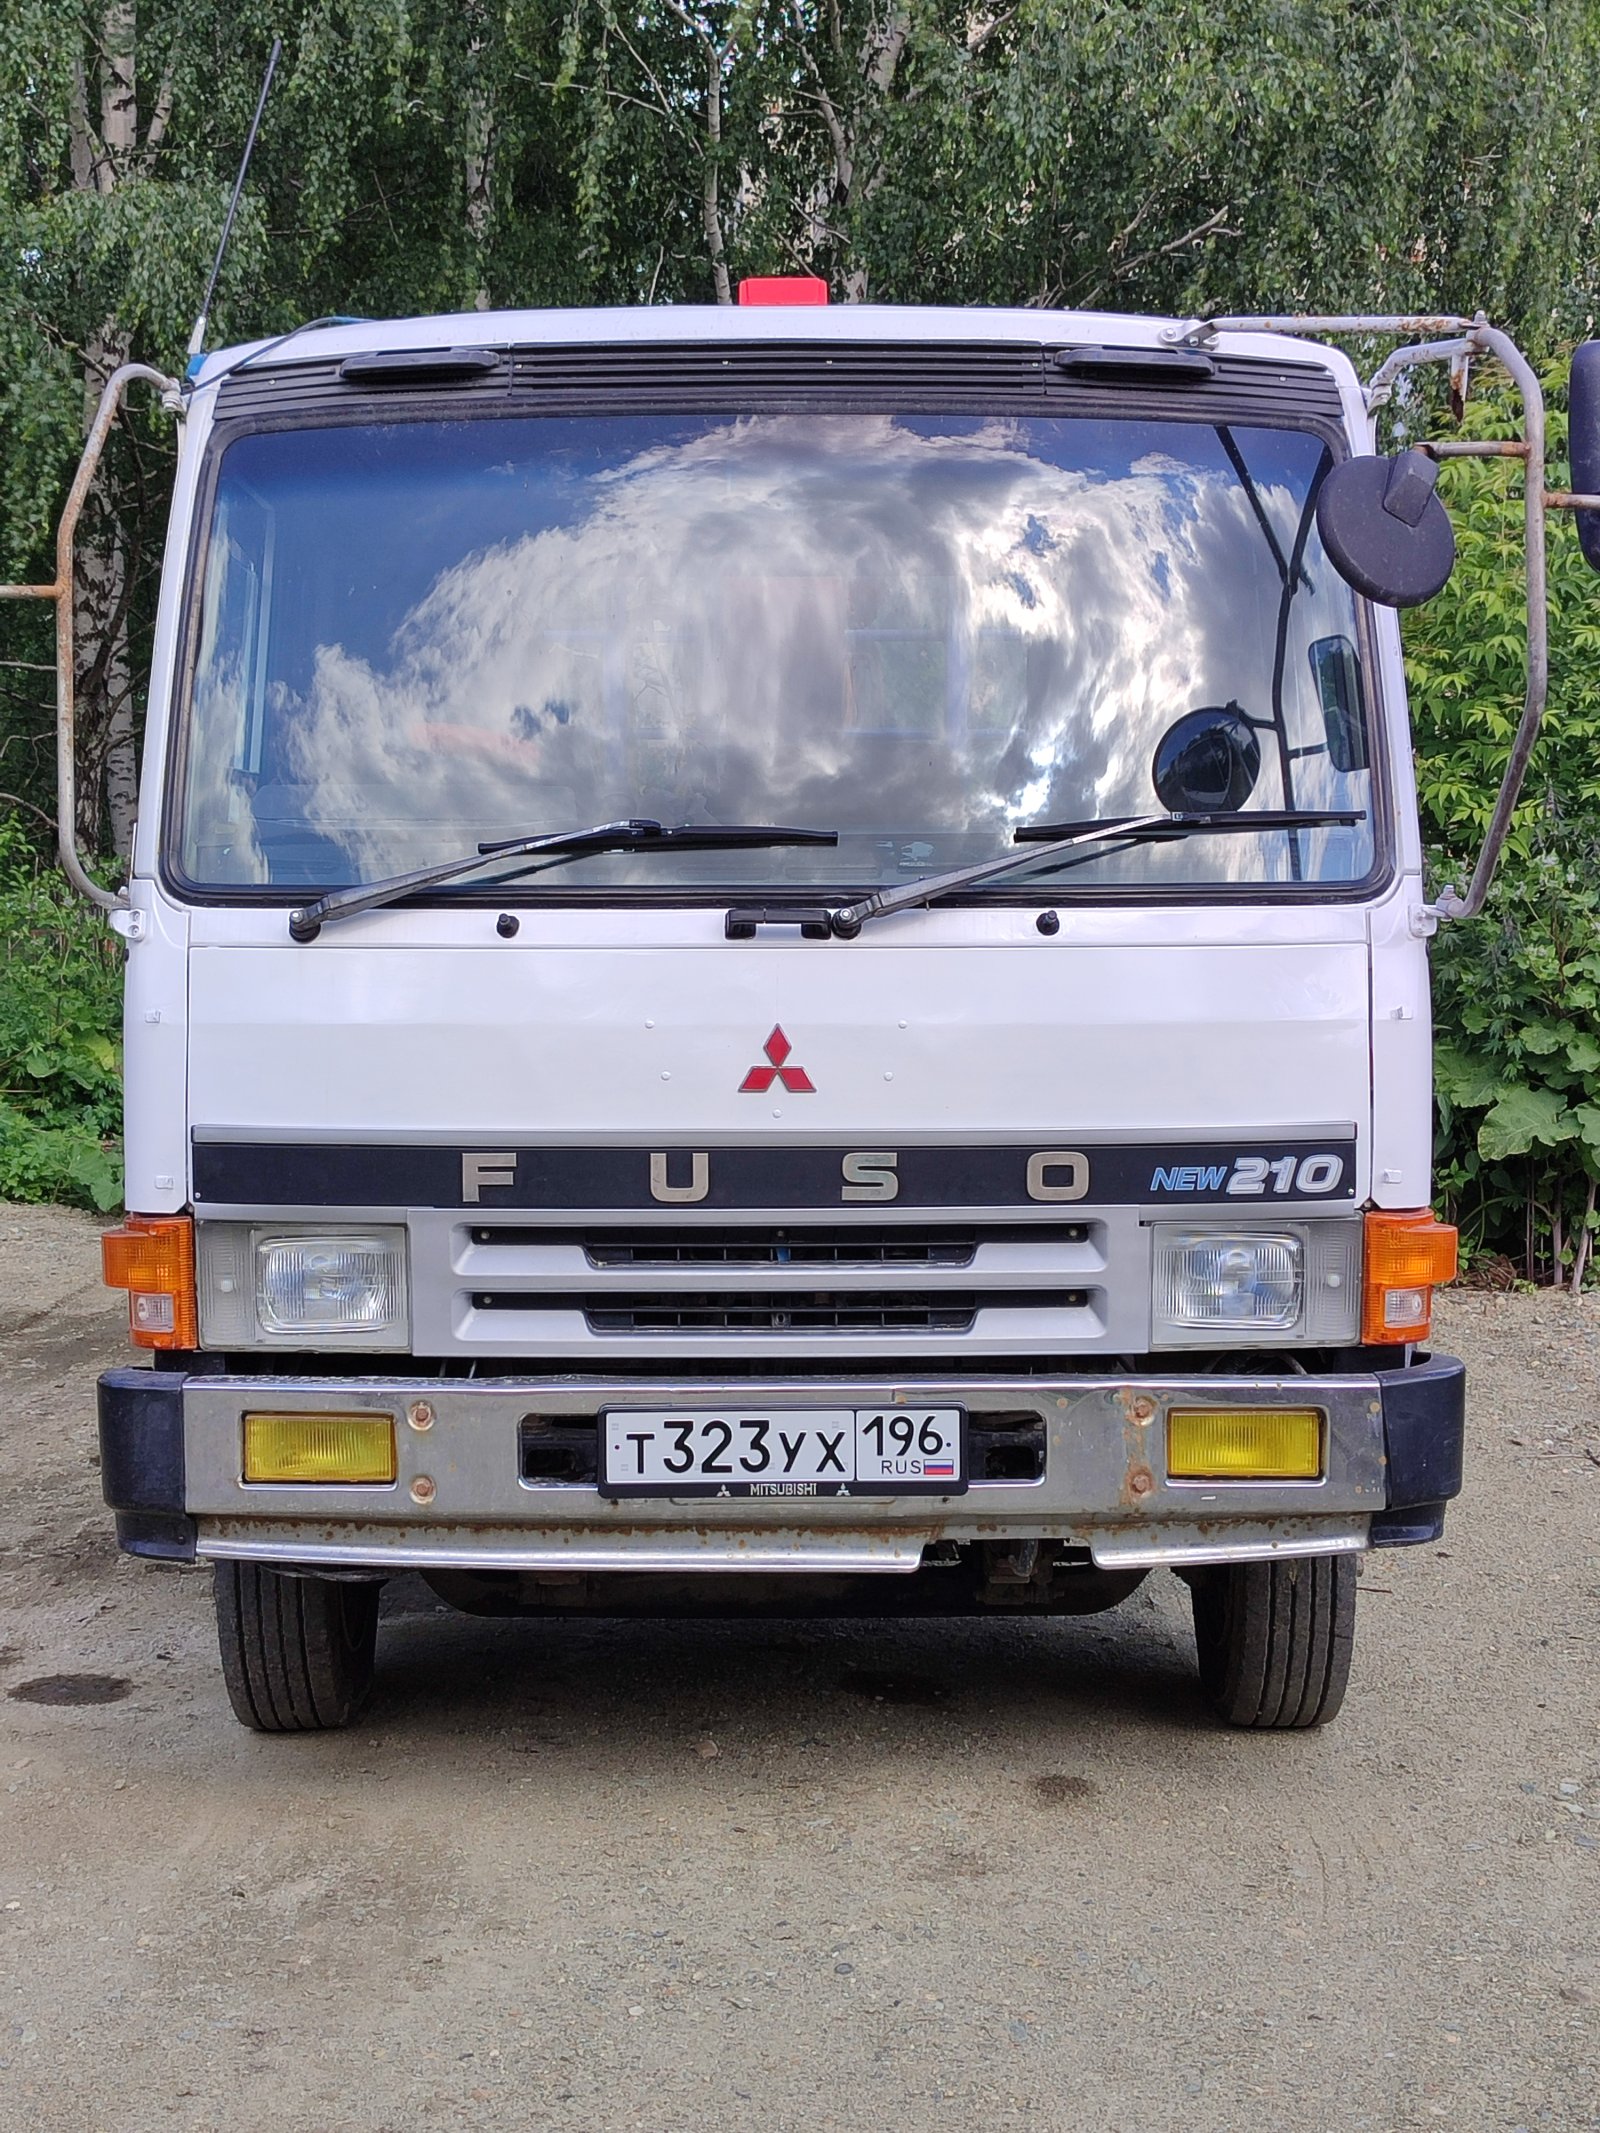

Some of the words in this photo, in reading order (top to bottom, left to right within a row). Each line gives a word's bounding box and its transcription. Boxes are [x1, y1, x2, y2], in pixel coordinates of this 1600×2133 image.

[462, 1152, 1091, 1203] FUSO
[1150, 1166, 1227, 1191] NEW
[1226, 1154, 1344, 1195] 210
[862, 1415, 943, 1456] 196
[881, 1460, 921, 1475] RUS
[749, 1483, 817, 1496] MITSUBISHI
